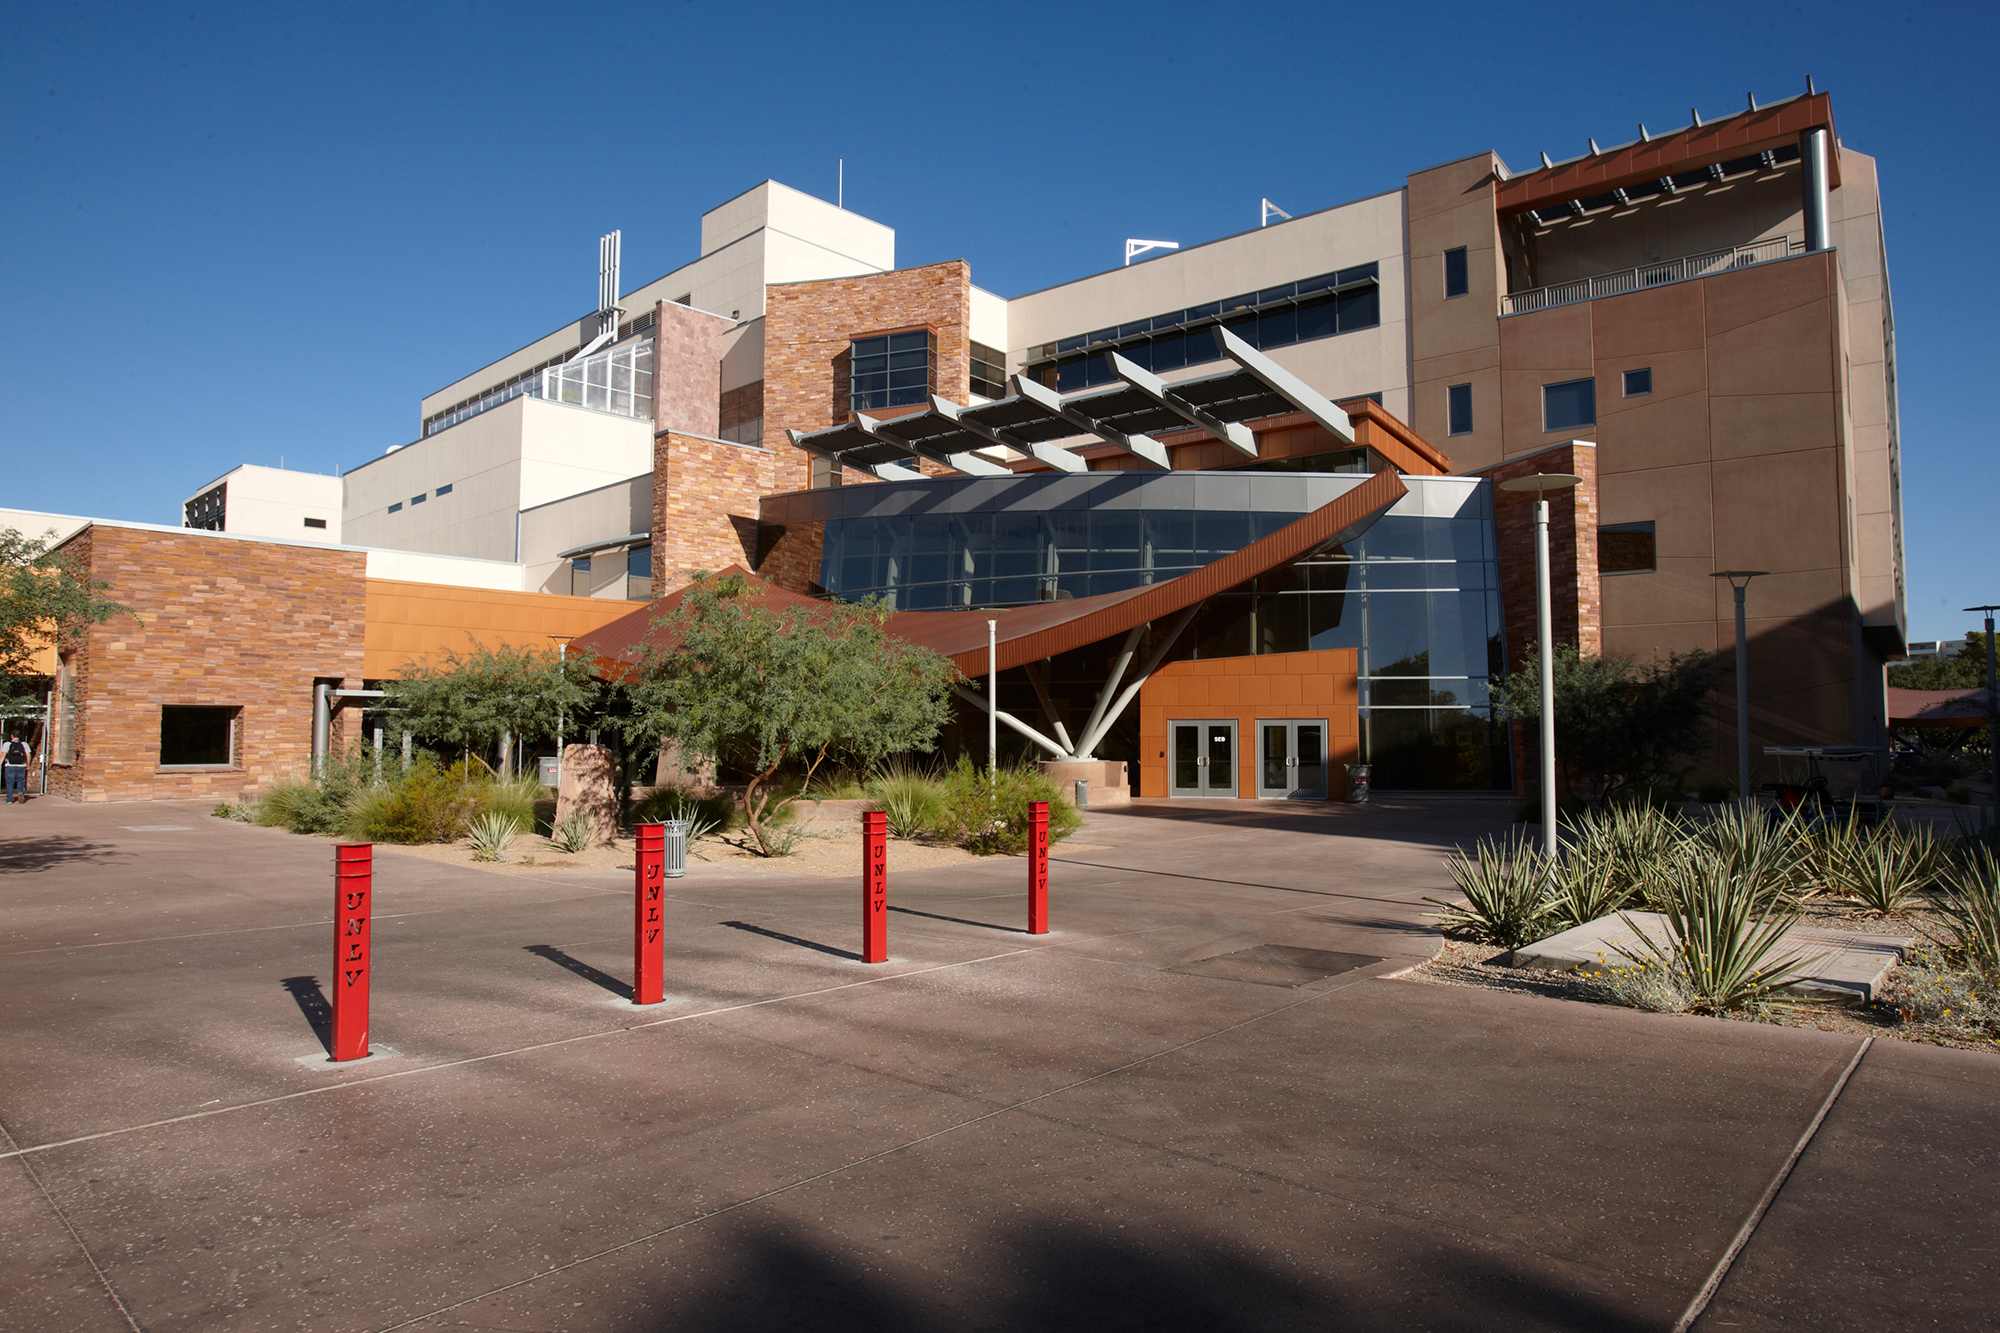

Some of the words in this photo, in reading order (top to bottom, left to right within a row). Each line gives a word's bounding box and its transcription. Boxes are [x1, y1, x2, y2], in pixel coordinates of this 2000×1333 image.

[873, 845, 885, 913] UNLV
[1038, 831, 1047, 890] UNLV
[344, 892, 366, 988] UNLV
[645, 864, 661, 944] UNLV
